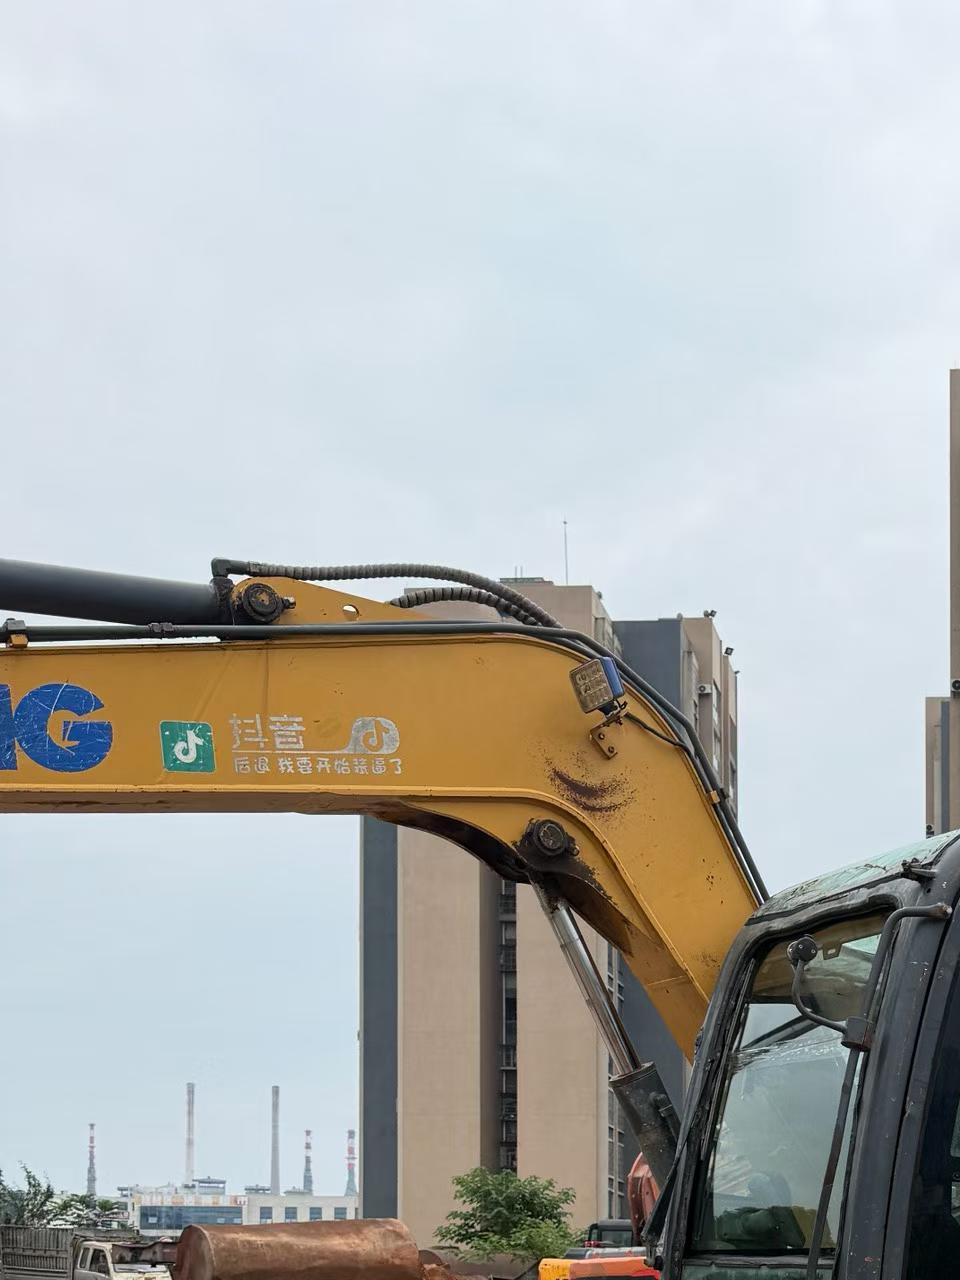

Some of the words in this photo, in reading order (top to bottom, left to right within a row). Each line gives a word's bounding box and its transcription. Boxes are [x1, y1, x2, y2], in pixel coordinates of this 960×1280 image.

[0, 683, 113, 773] G
[229, 713, 306, 749] 抖音
[234, 756, 270, 774] 后退
